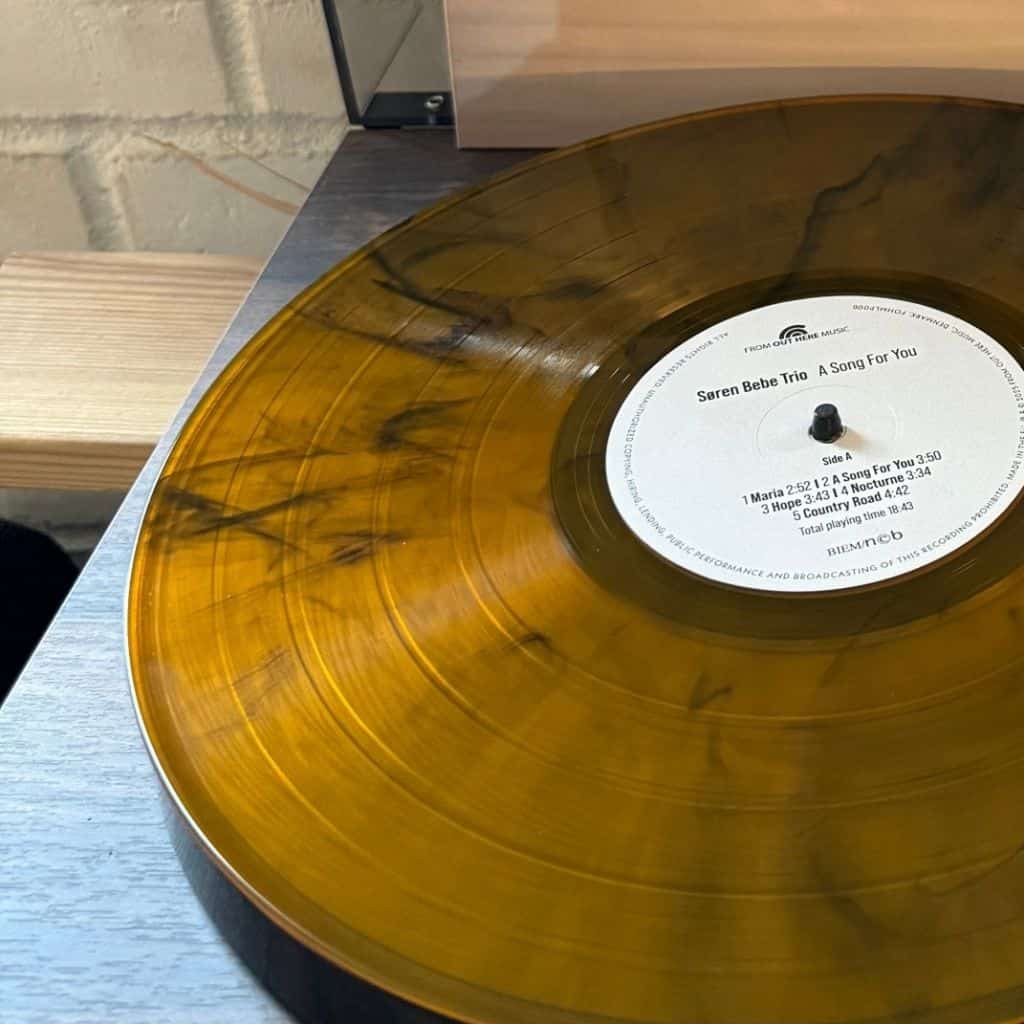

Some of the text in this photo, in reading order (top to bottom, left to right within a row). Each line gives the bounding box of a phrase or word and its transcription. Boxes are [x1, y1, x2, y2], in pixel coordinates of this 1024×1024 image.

[743, 326, 848, 354] FROM OUT HERE MUSIC
[975, 342, 992, 356] HERE
[990, 356, 1004, 368] OUT
[696, 345, 918, 403] Søren Bebe Trio A Song For You
[1001, 368, 1016, 385] FROM
[822, 451, 853, 466] Side A
[1016, 450, 1024, 459] IN
[742, 495, 748, 506] 1
[750, 488, 785, 505] Maria
[786, 480, 812, 496] 2:52
[821, 476, 830, 488] 2
[832, 474, 841, 485] A
[843, 467, 871, 483] Song
[873, 463, 892, 476] For
[892, 457, 915, 471] You
[916, 450, 942, 465] 3:50
[1007, 460, 1022, 481] MADE
[761, 504, 770, 515] 3
[771, 497, 802, 514] Hope
[804, 489, 830, 505] 3:43
[840, 485, 849, 497] 4
[850, 473, 905, 494] Nocturne
[905, 466, 932, 481] 3:34
[793, 484, 911, 521] 5 Country Road 4:42
[799, 501, 914, 537] Total playing time 18:43
[666, 533, 695, 555] PUBLIC
[921, 520, 973, 553] RECORDING
[694, 550, 764, 578] PERFORMANCE
[880, 559, 894, 569] OF
[897, 550, 920, 564] THIS
[766, 571, 790, 580] AND
[792, 564, 878, 581] BROADCASTING
